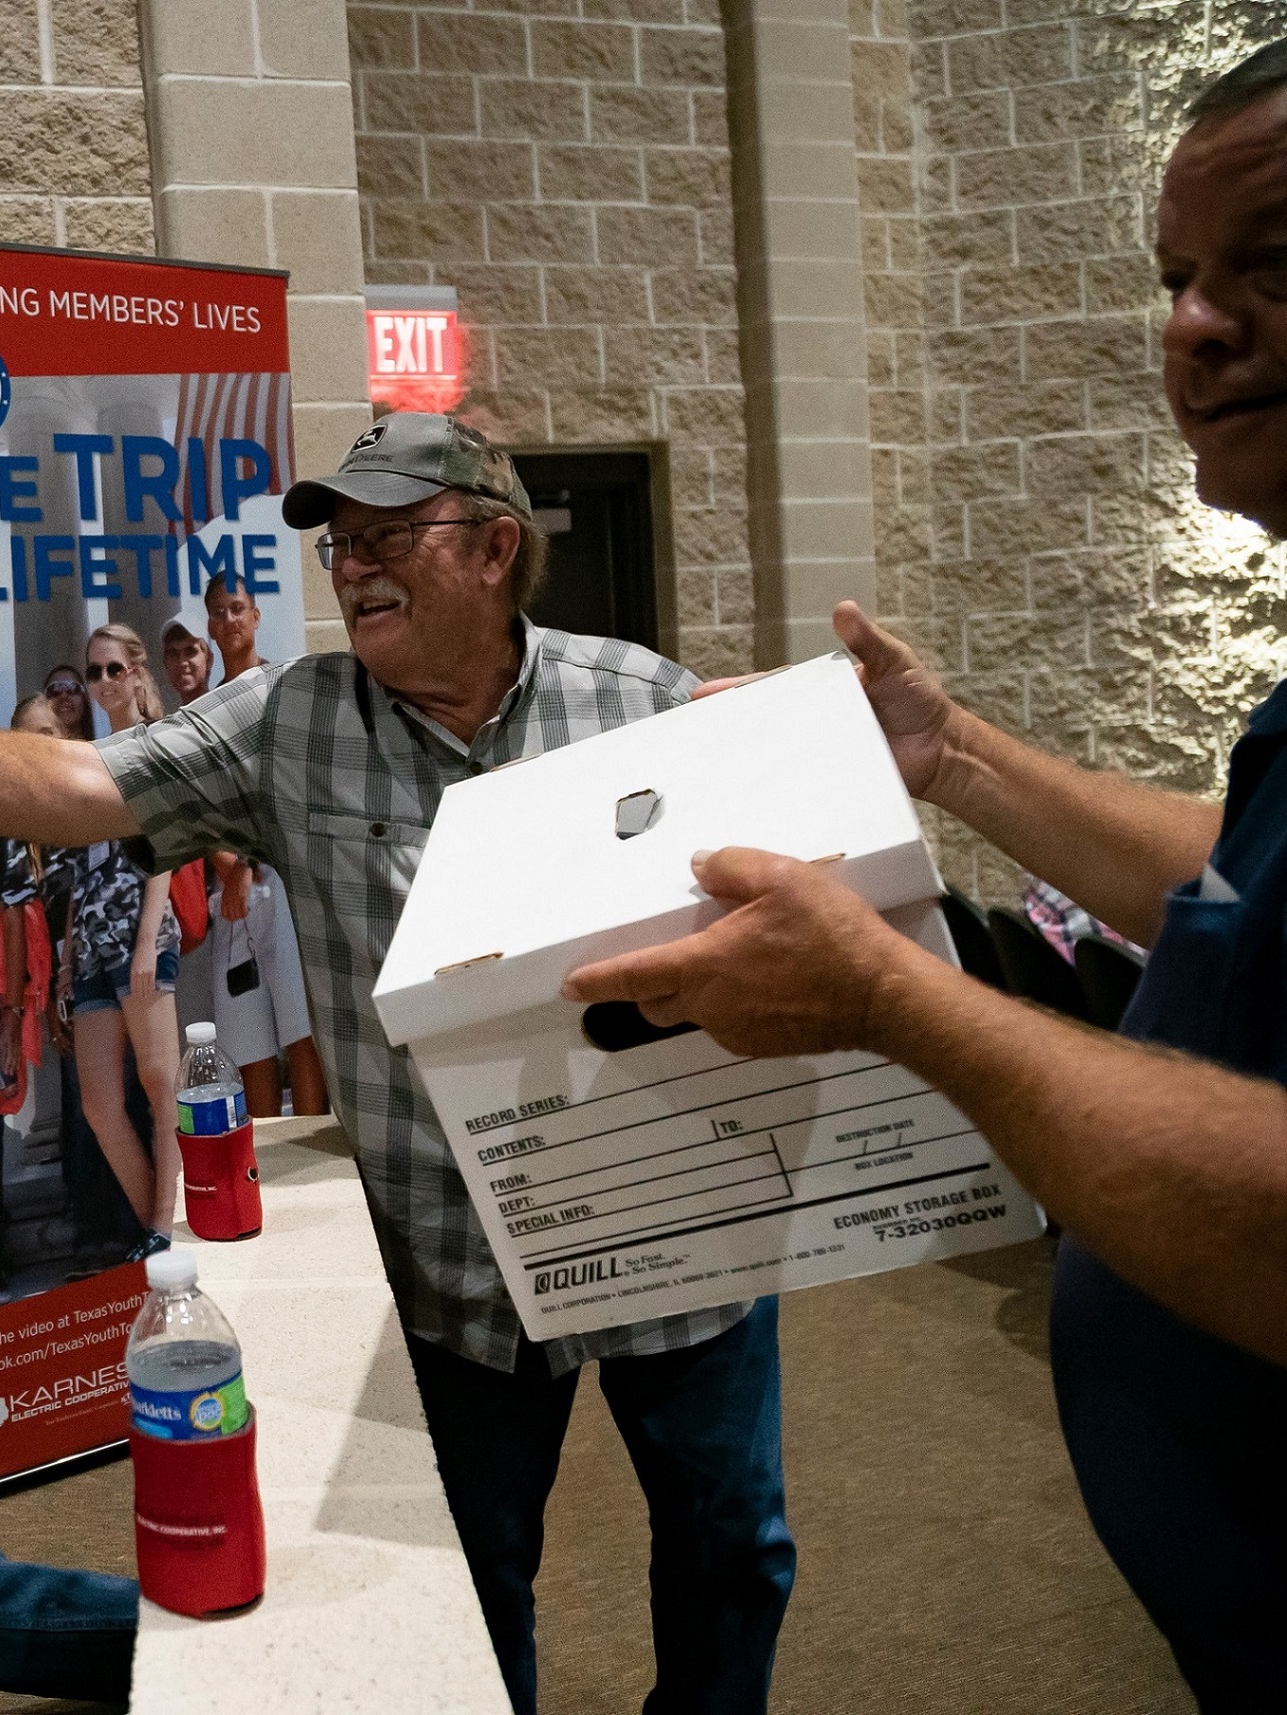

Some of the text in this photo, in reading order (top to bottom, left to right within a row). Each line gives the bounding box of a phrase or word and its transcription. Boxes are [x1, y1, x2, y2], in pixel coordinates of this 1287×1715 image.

[193, 302, 261, 333] LIVES
[374, 316, 447, 373] EXIT
[53, 433, 271, 523] TRIP
[465, 1095, 570, 1133] RECORD SERIES:
[477, 1135, 545, 1162] CONTENTS:
[490, 1120, 743, 1193] FROM: TO:
[498, 1196, 535, 1214] DEPT:
[506, 1204, 595, 1235] SPECIAL INFO:
[833, 1205, 901, 1230] ECONOMY
[904, 1190, 970, 1214] STORAGE
[973, 1184, 1001, 1200] BOX
[874, 1204, 1007, 1242] 7-32030QQW
[553, 1257, 623, 1290] QUILL
[625, 1258, 640, 1268] So
[632, 1266, 648, 1275] So
[18, 1320, 54, 1339] video
[57, 1314, 70, 1329] at
[73, 1291, 149, 1324] TexasYouthT
[9, 1361, 129, 1412] KARNES
[11, 1401, 62, 1423] ELECTRIC
[64, 1381, 130, 1406] COOPERATIV
